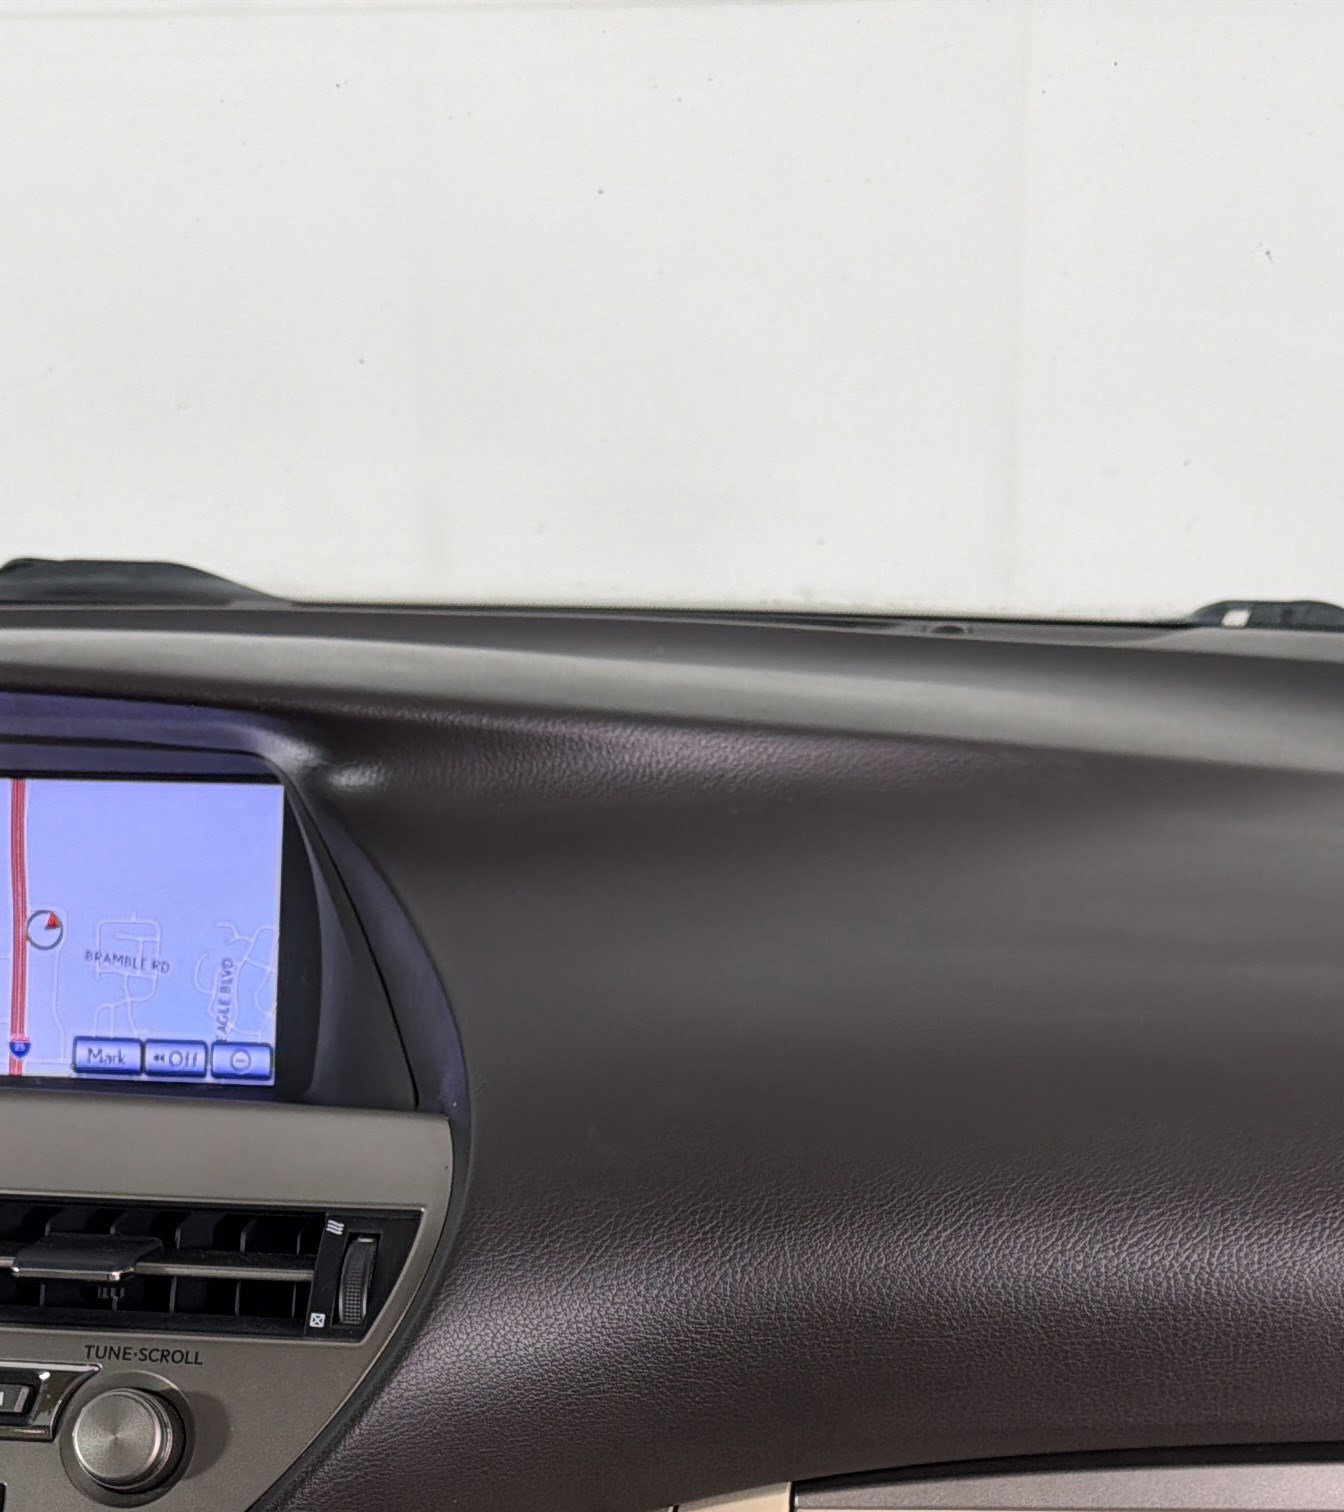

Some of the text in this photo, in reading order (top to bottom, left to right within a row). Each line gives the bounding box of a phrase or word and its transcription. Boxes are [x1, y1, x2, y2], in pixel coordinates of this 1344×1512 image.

[85, 950, 148, 972] BRAMBLE
[87, 1048, 126, 1066] Mark
[168, 1050, 198, 1068] Off
